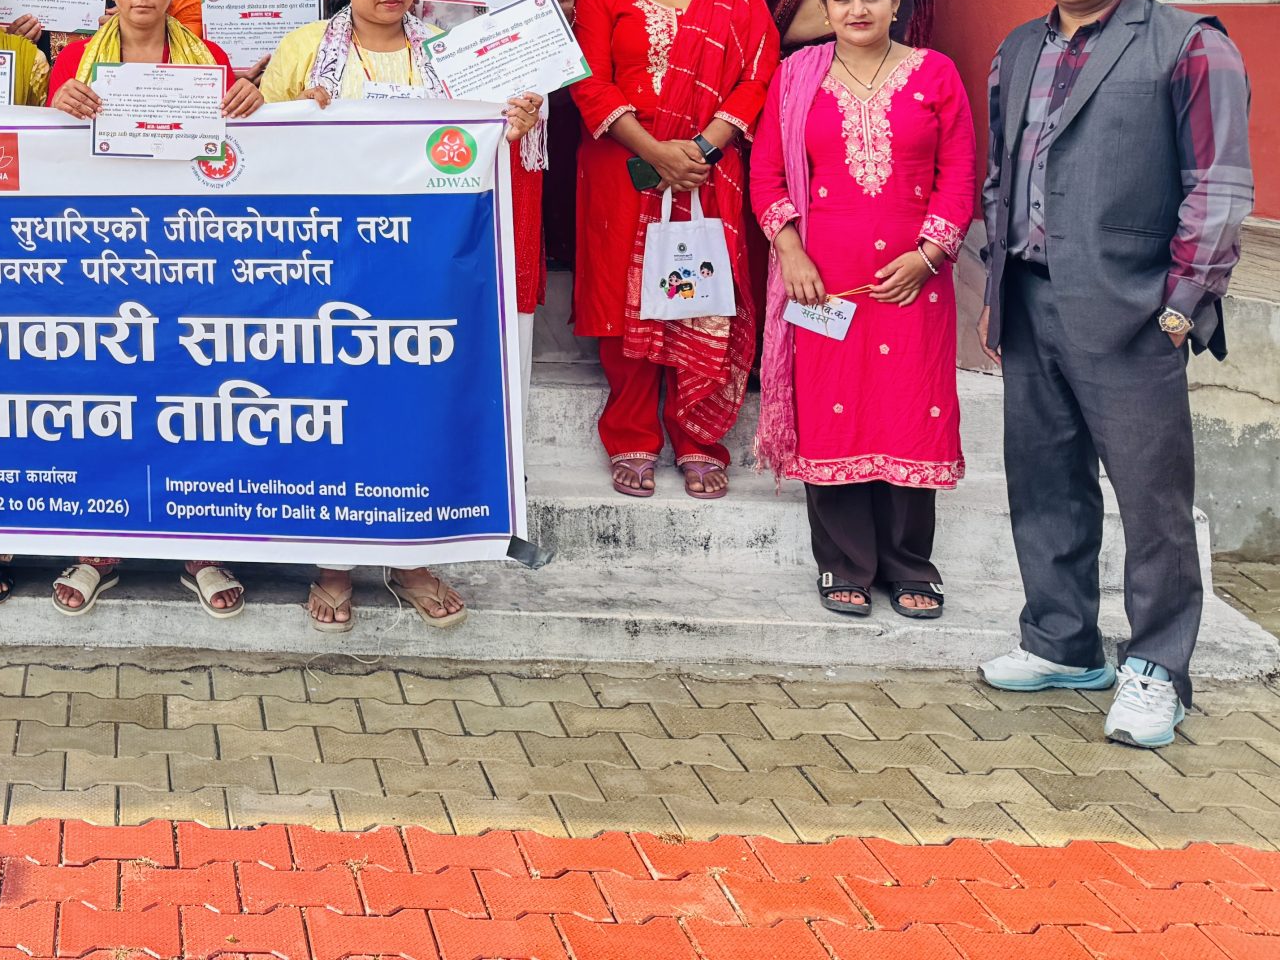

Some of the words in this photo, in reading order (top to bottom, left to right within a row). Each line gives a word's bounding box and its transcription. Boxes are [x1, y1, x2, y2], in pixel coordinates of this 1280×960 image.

[426, 177, 481, 189] ADWAN
[10, 207, 149, 251] सुधारिएको
[164, 206, 342, 243] जीविकोपार्जन
[357, 216, 411, 244] तथा
[81, 249, 216, 285] परियोजना
[231, 249, 334, 285] अन्तर्गत
[178, 301, 458, 367] सामाजिक
[155, 379, 348, 446] तालिम
[26, 466, 77, 484] कार्यालय
[165, 477, 234, 498] Improved
[238, 479, 314, 496] Livelihood
[319, 481, 346, 497] and
[355, 482, 429, 498] Economic
[9, 498, 23, 511] to
[27, 498, 46, 512] 06
[49, 498, 84, 516] May,
[87, 498, 130, 517] 2026)
[165, 500, 252, 521] Opportunity
[256, 502, 278, 518] for
[281, 502, 316, 520] Dalit
[319, 504, 331, 520] &
[334, 506, 433, 526] Marginalized
[437, 502, 490, 520] Women
